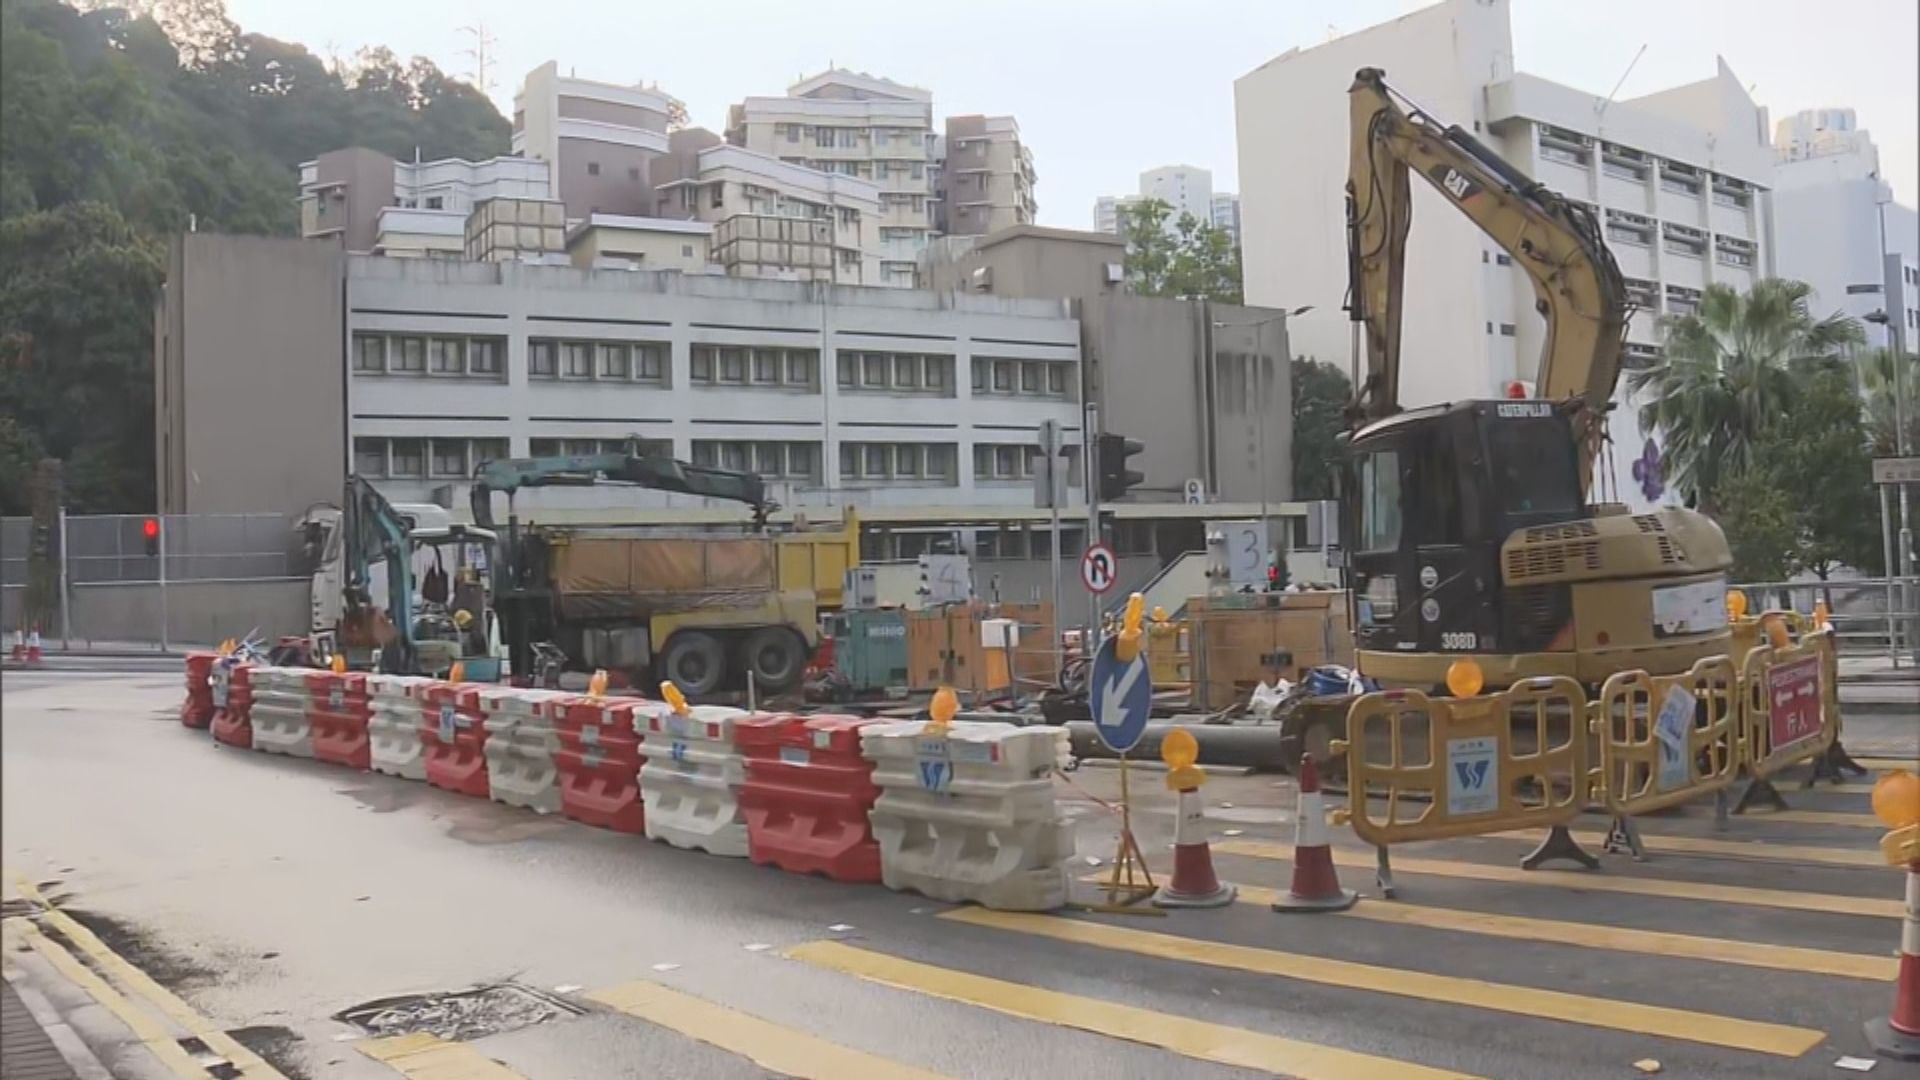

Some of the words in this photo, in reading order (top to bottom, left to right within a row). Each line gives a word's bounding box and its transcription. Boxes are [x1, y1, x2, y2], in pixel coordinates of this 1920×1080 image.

[1443, 169, 1470, 198] CAT
[1242, 529, 1261, 571] 3
[938, 562, 963, 600] 4
[1441, 632, 1477, 650] 308D
[1786, 709, 1809, 739] 行人
